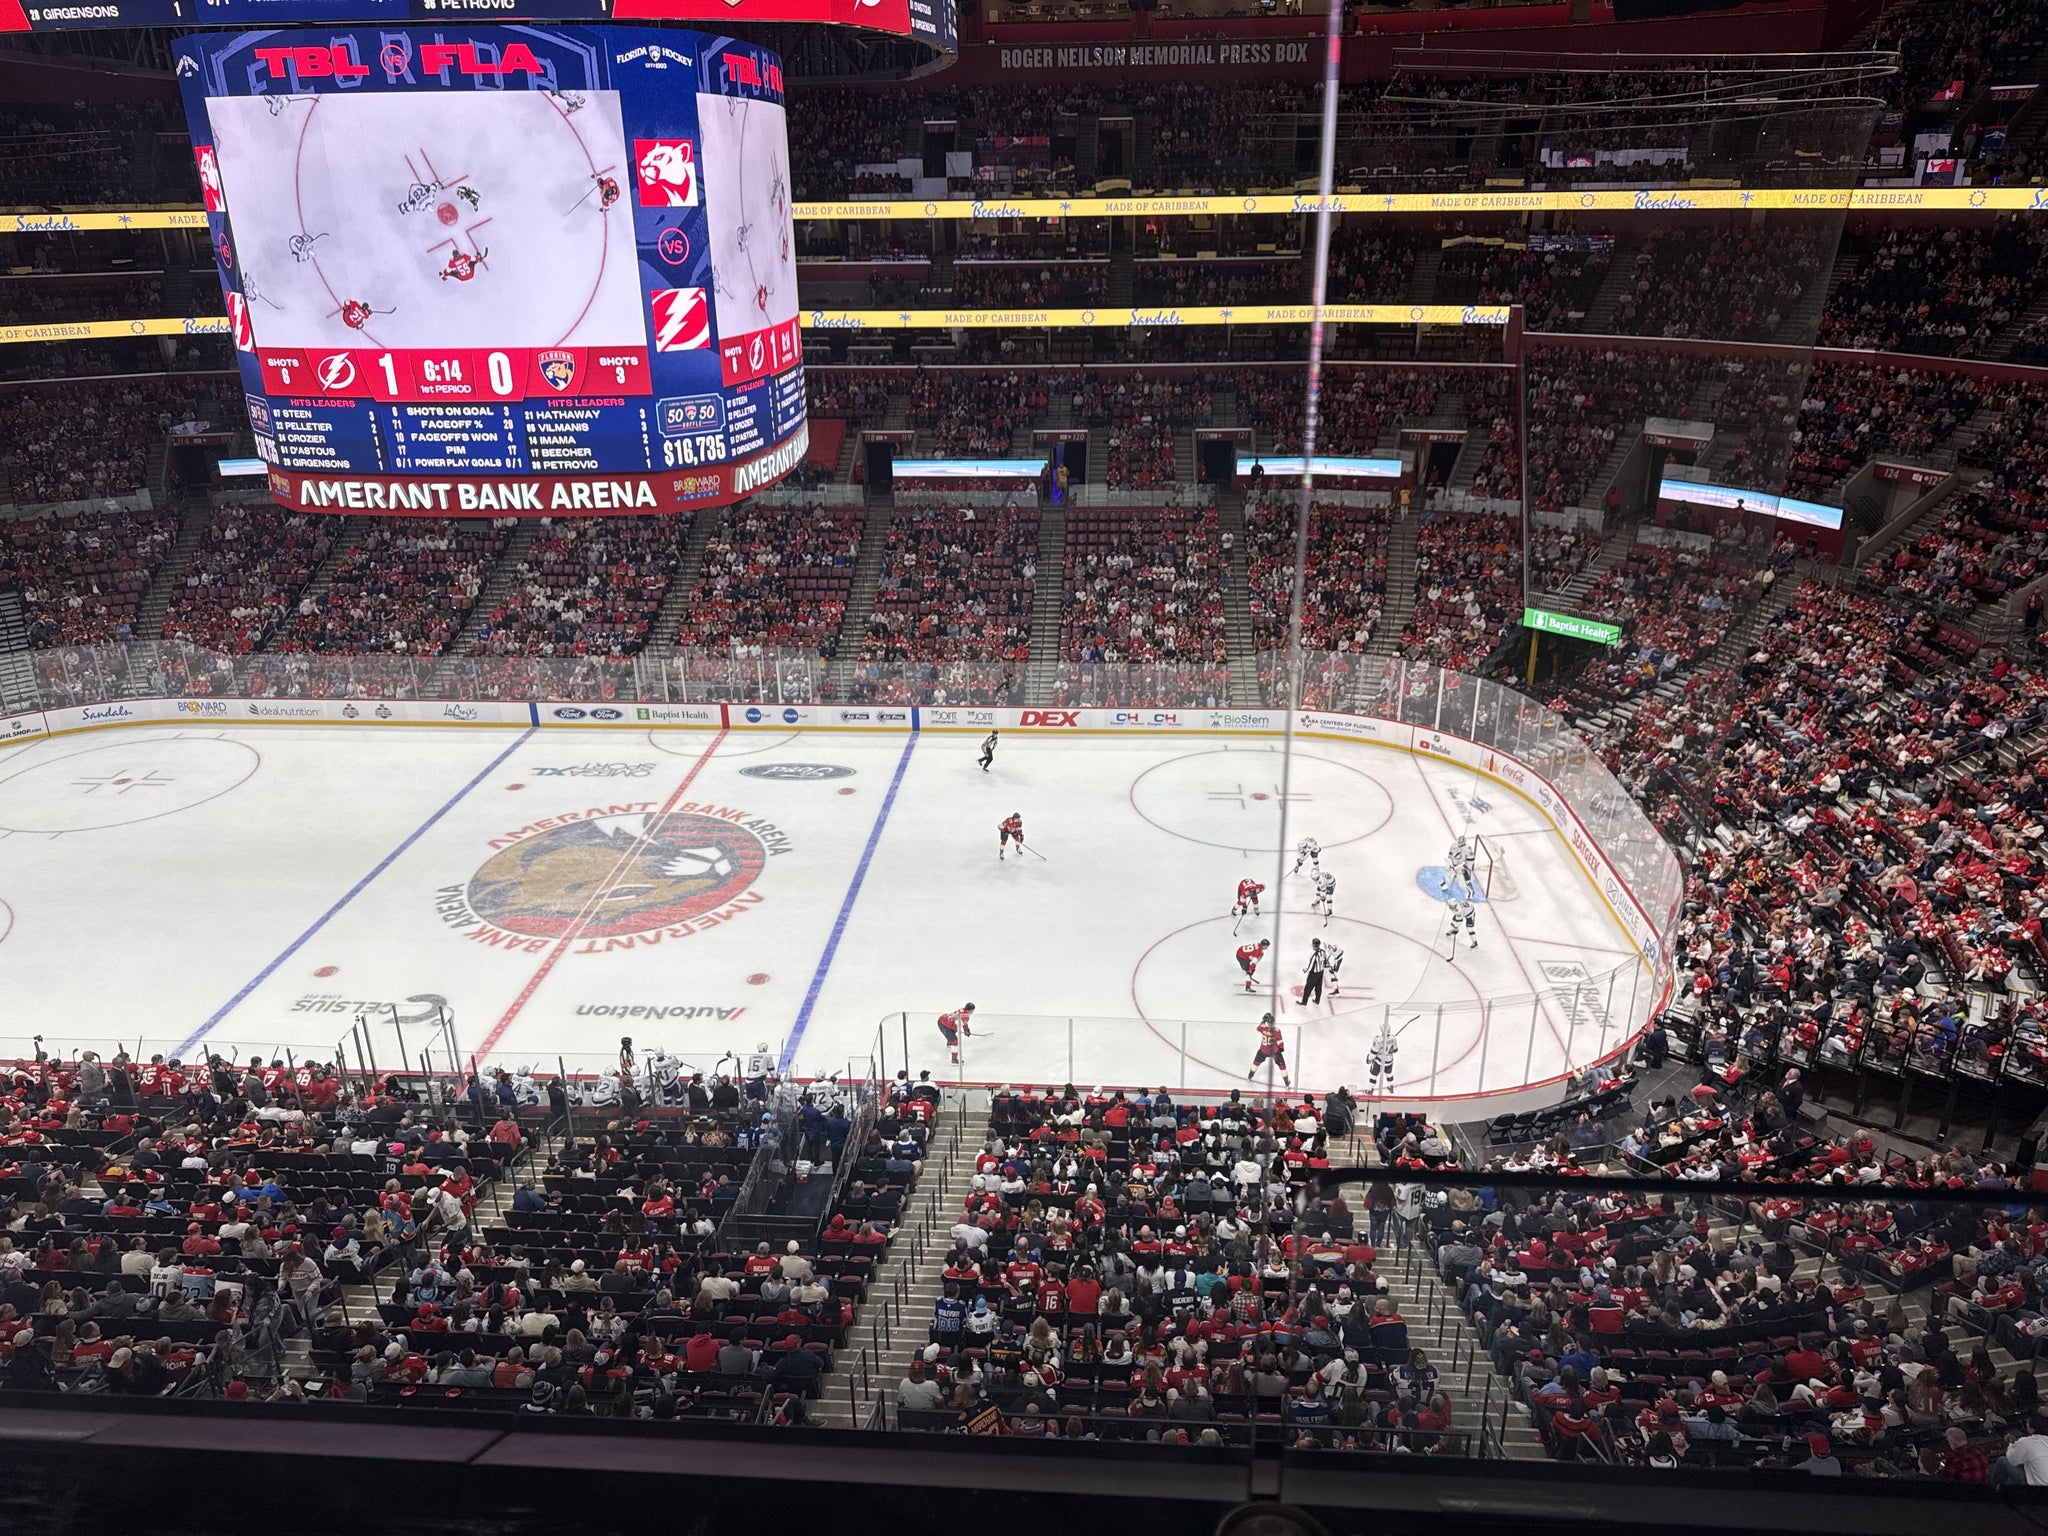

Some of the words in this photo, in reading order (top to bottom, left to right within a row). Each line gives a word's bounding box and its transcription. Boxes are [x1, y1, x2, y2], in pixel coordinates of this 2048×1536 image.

[43, 6, 119, 21] GIRGENSONS
[254, 46, 370, 79] TBL
[385, 54, 402, 68] VS
[419, 43, 544, 75] FLA
[616, 47, 648, 64] FLORIDA
[662, 48, 693, 67] HOCKEY
[1001, 48, 1053, 69] ROGER
[1057, 46, 1125, 67] NEILSON
[1130, 44, 1215, 66] MEMORIAL
[1220, 43, 1271, 64] PRESS
[1275, 43, 1308, 63] BOX
[723, 53, 762, 87] TBL
[1431, 198, 1461, 207] MADE
[1464, 197, 1479, 206] OF
[1481, 196, 1543, 206] CARIBBEAN
[1634, 191, 1697, 209] Beaches
[1793, 194, 1826, 204] MADE
[1831, 194, 1848, 204] OF
[1850, 194, 1923, 204] CARIBBEAN
[821, 207, 833, 215] OF
[836, 206, 891, 215] CARIBBEAN
[971, 199, 1025, 217] Beaches
[1105, 203, 1133, 211] MADE
[1136, 202, 1148, 211] OF
[1152, 202, 1209, 210] CARIBBEAN
[17, 215, 80, 231] Sandals
[169, 216, 198, 225] MADE
[664, 240, 684, 255] VS
[811, 310, 865, 327] Beaches
[945, 314, 972, 323] MADE
[975, 314, 988, 323] OF
[991, 314, 1047, 322] CARIBBEAN
[1128, 307, 1184, 325] Sandals
[1267, 310, 1296, 319] MADE
[1299, 310, 1312, 318] OF
[6, 330, 20, 339] OF
[25, 326, 91, 338] CARIBBEAN
[770, 330, 777, 369] 1
[268, 359, 299, 367] SHOTS
[599, 357, 639, 366] SHOTS
[378, 353, 399, 395] 1
[423, 359, 463, 382] 6:14
[487, 352, 513, 396] 0
[615, 367, 626, 385] 3
[420, 385, 435, 393] 1st
[435, 385, 471, 393] PERIOD
[291, 399, 311, 407] HITS
[312, 400, 356, 408] LEADERS
[548, 399, 573, 407] HITS
[575, 398, 625, 407] LEADERS
[283, 409, 312, 419] STEEN
[407, 407, 444, 416] SHOTS
[445, 407, 461, 416] ON
[463, 407, 495, 416] GOAL
[503, 406, 509, 416] 3
[536, 410, 600, 420] HATHAWAY
[639, 409, 645, 419] 3
[668, 408, 684, 423] 50
[700, 405, 715, 420] 50
[285, 422, 333, 432] PELLETIER
[392, 419, 402, 429] 71
[421, 420, 472, 429] FACEOFF
[474, 421, 483, 429] %
[538, 423, 589, 432] VILMANIS
[641, 421, 647, 432] 3
[682, 421, 703, 429] RAFFLE
[287, 435, 326, 444] CROZIER
[411, 433, 470, 442] FACEOFFS
[472, 433, 498, 442] WON
[507, 432, 513, 442] 4
[540, 436, 576, 445] IMAMA
[642, 434, 649, 444] 2
[1073, 433, 1085, 441] 120
[1198, 432, 1210, 440] 120
[1409, 433, 1421, 441] 121
[1645, 433, 1658, 444] 123
[398, 445, 407, 455] 17
[446, 446, 466, 455] PIM
[507, 445, 517, 455] 17
[663, 434, 726, 467] $16,735
[1693, 440, 1707, 450] 124
[290, 446, 336, 456] D'ASTOUS
[541, 448, 592, 457] BEECHER
[645, 446, 650, 456] 1
[293, 459, 351, 469] GIRGENSONS
[396, 458, 412, 469] 0/1
[415, 459, 446, 467] POWER
[447, 459, 470, 467] PLAY
[471, 459, 502, 467] GOALS
[505, 458, 522, 469] 0/1
[543, 460, 599, 470] PETROVIC
[646, 459, 651, 469] 1
[736, 444, 794, 494] AMERANT
[1885, 467, 1900, 479] 124
[697, 484, 720, 493] COUNTY
[300, 480, 451, 510] AMERANT
[458, 483, 544, 510] BANK
[551, 480, 658, 510] ARENA
[1549, 618, 1579, 633] Baptist
[1581, 624, 1611, 639] Health
[82, 705, 133, 720] Sandals
[258, 705, 319, 717] idealnutrition
[559, 708, 582, 719] Ford
[595, 708, 618, 719] Ford
[652, 709, 679, 720] Baptist
[682, 709, 709, 720] Health
[938, 711, 958, 720] JOINT
[974, 712, 993, 721] JOINT
[1020, 711, 1081, 726] DEX
[1116, 713, 1138, 722] CH
[1154, 714, 1176, 722] CH
[1224, 714, 1269, 724] BioStem
[1430, 744, 1451, 755] YouTube
[531, 766, 577, 777] XL
[577, 762, 656, 771] SPORT
[761, 765, 833, 778] Ford
[570, 769, 651, 778] OMEGA
[487, 802, 659, 851] AMERANT
[679, 802, 752, 825] BANK
[743, 818, 793, 857] ARENA
[1572, 828, 1601, 879] SEATGEEK
[435, 882, 477, 933] ARENA
[1618, 893, 1640, 929] SIMPLE
[574, 889, 765, 956] AMERANT
[463, 925, 550, 959] BANK
[290, 1000, 395, 1016] CELSIUS
[576, 1004, 736, 1019] AutoNation
[163, 1082, 172, 1096] 11
[386, 1163, 396, 1174] 19
[1410, 1189, 1421, 1206] 19
[1045, 1295, 1057, 1310] 16
